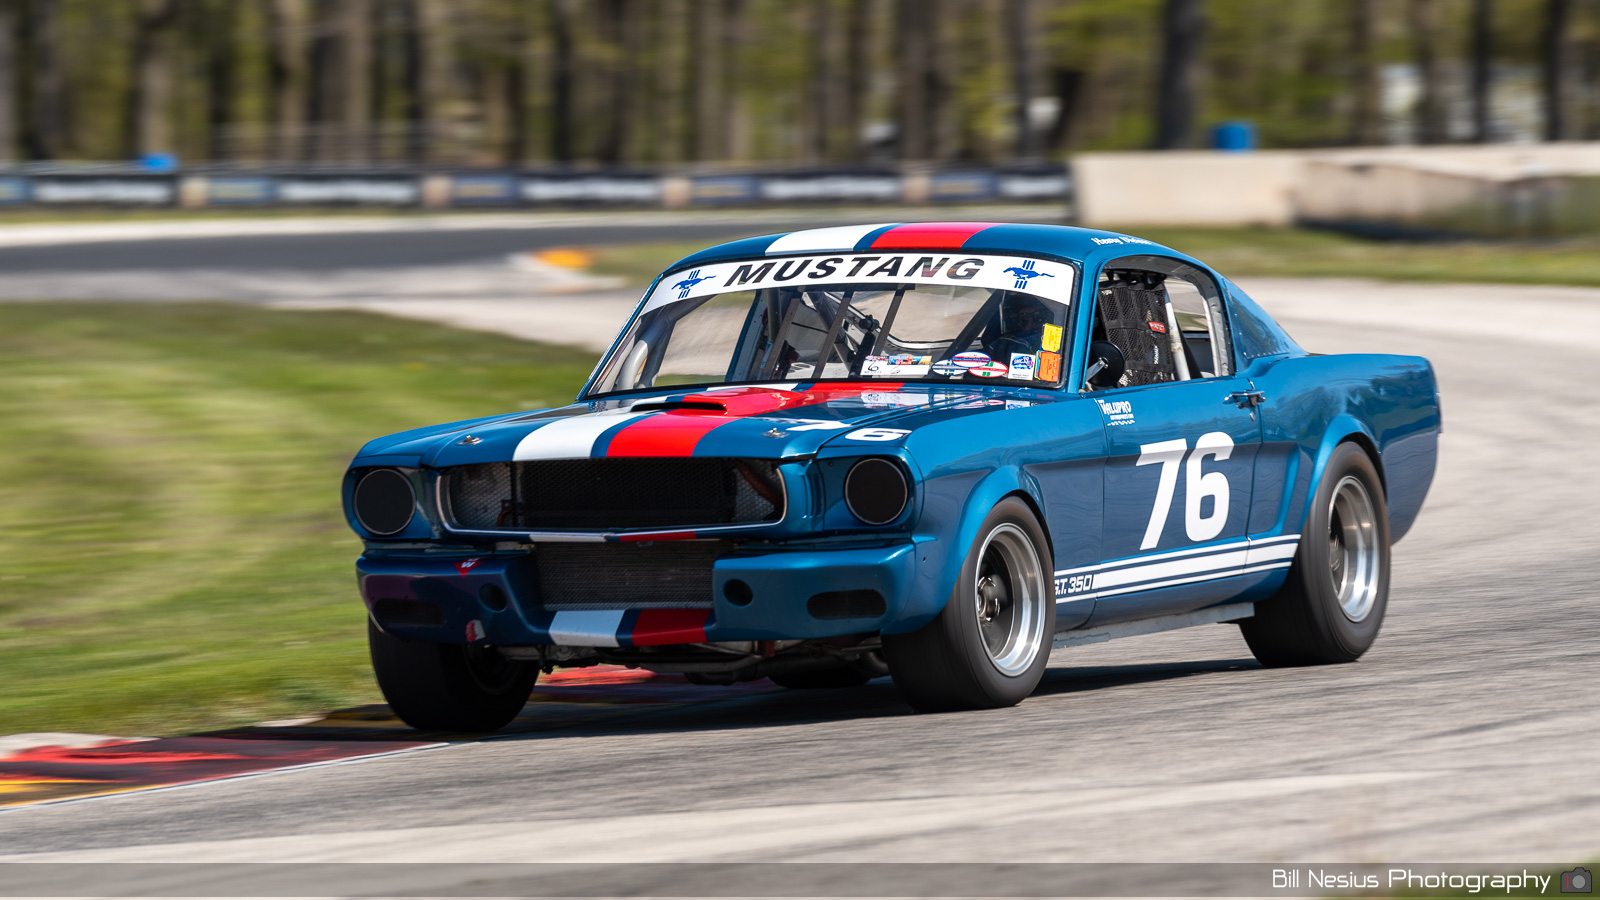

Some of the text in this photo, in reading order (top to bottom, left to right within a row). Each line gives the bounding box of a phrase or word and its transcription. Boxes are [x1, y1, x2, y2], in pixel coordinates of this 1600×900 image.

[723, 255, 985, 287] MUSTANG
[786, 419, 912, 441] 76
[1136, 432, 1234, 550] 76
[1068, 574, 1092, 593] 350
